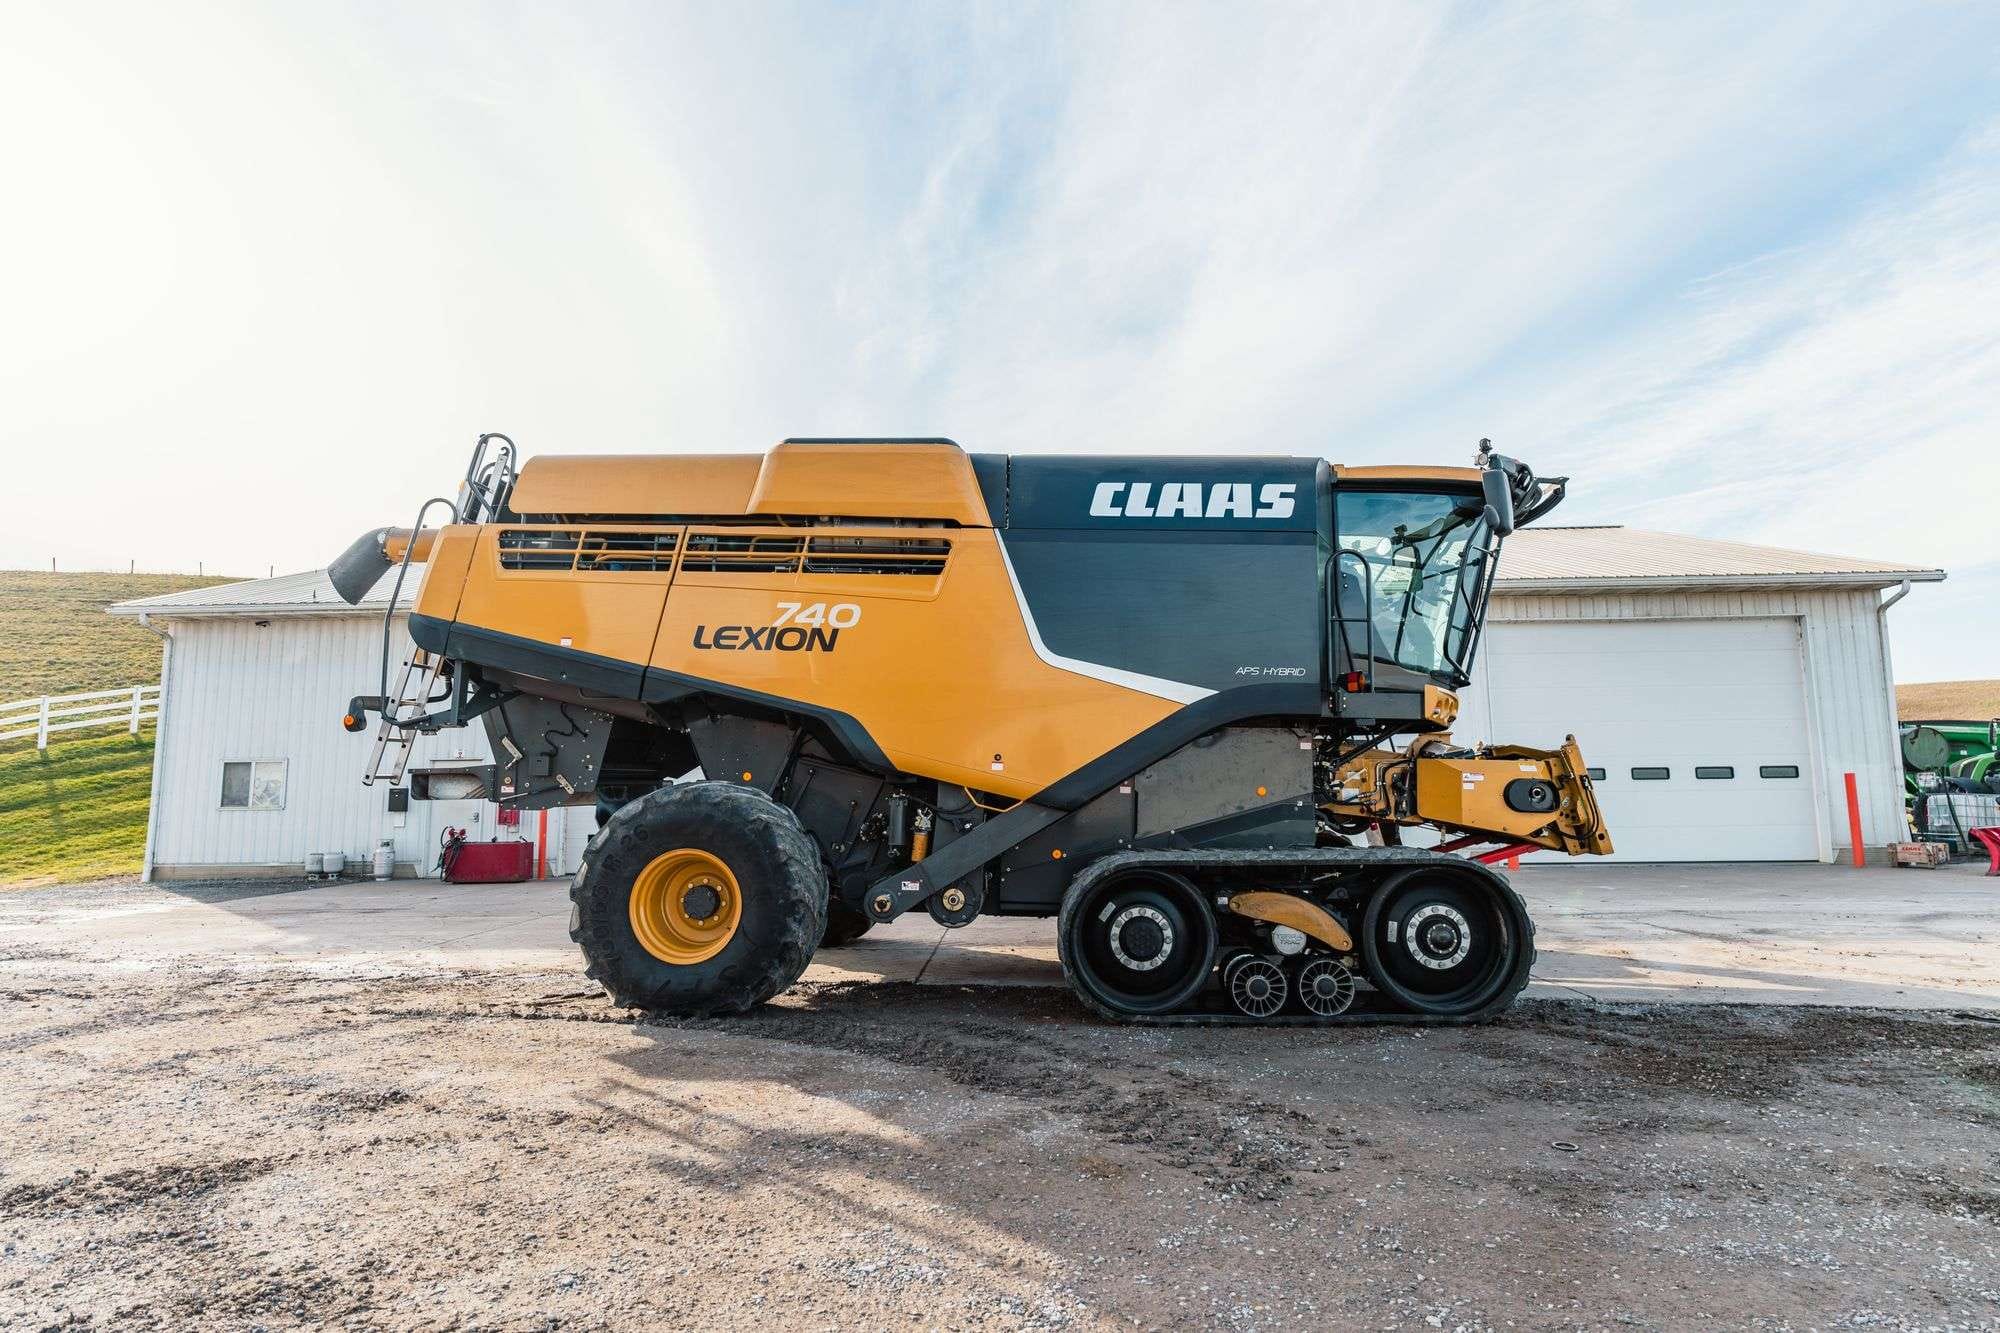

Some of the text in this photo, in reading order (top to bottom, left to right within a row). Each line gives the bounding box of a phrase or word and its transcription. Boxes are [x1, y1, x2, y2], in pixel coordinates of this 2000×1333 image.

[1089, 482, 1296, 518] CLAAS
[773, 601, 862, 629] 740
[693, 625, 839, 652] LEXION
[1235, 667, 1306, 677] APS HYBRID
